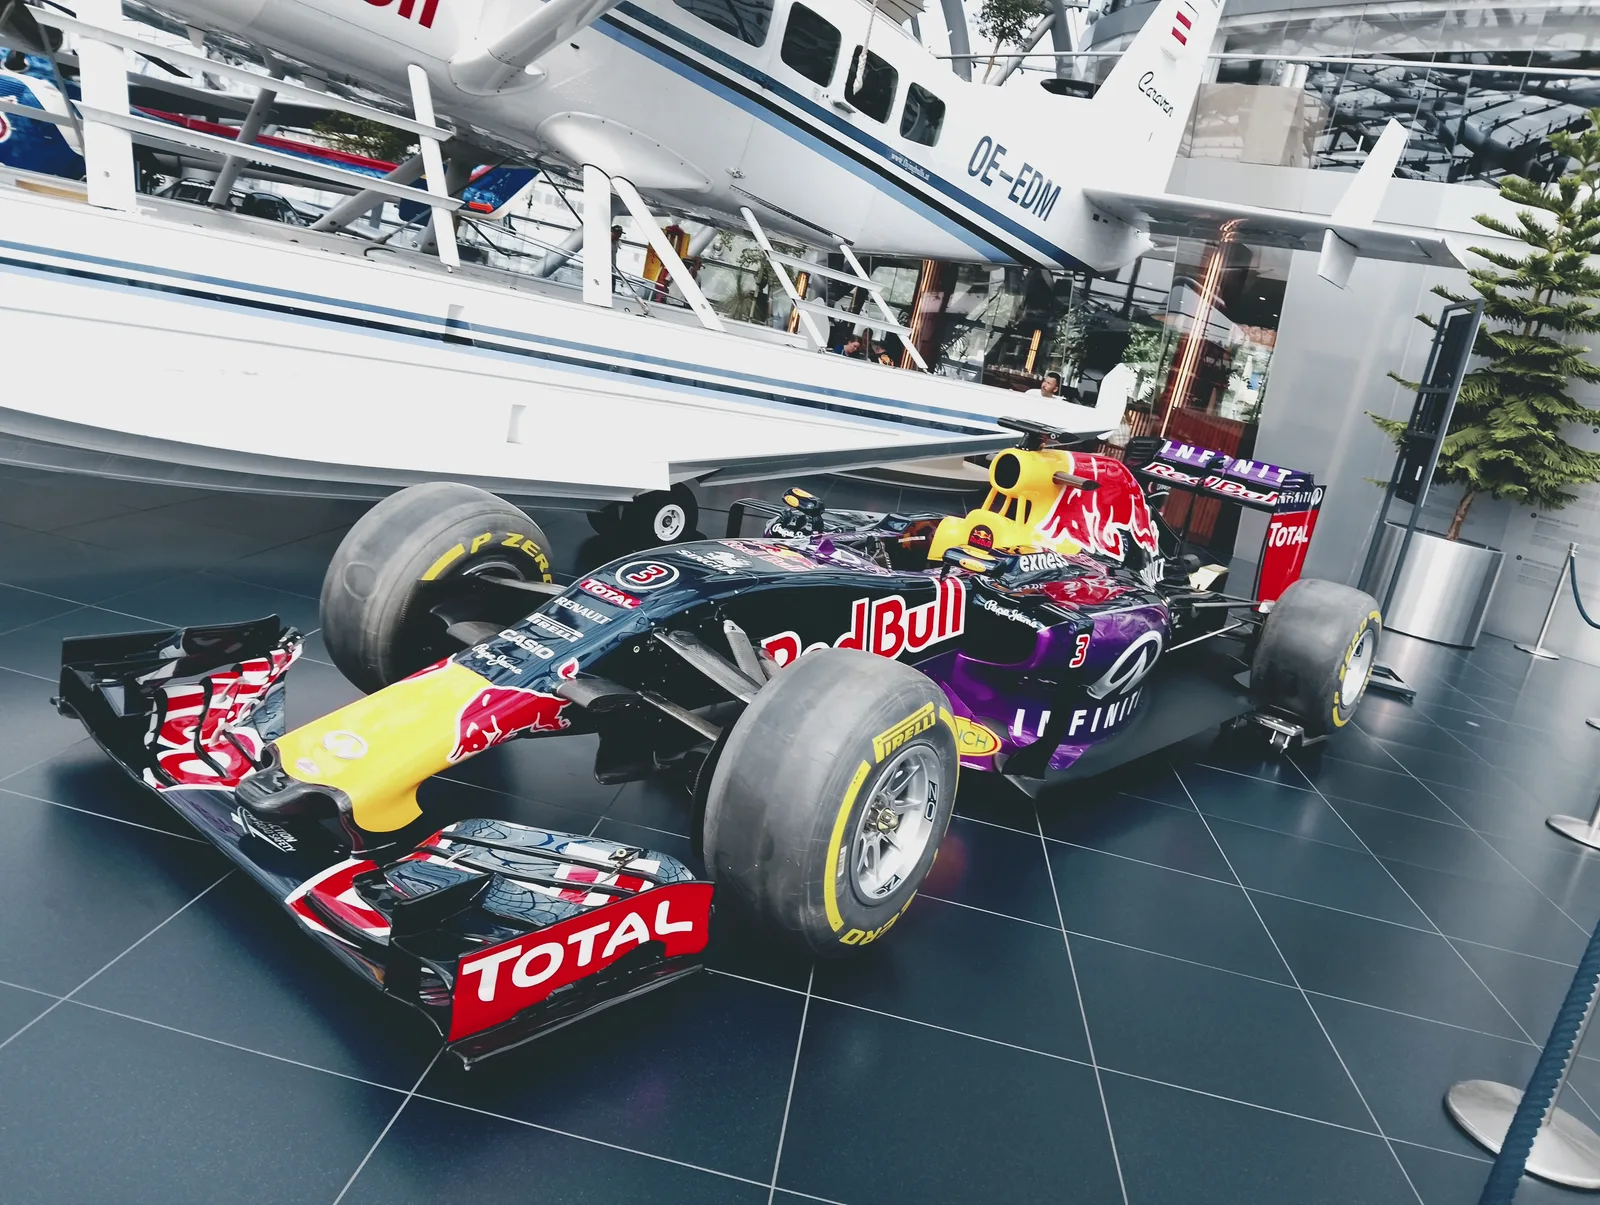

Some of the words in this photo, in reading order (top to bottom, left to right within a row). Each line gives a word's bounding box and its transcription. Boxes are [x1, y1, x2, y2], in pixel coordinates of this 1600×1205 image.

[1138, 71, 1174, 117] Caravan
[967, 135, 1062, 222] OE-EDM
[470, 532, 492, 554] P
[1267, 521, 1308, 548] TOTAL
[625, 564, 669, 584] 3
[1019, 551, 1069, 573] exness
[584, 579, 634, 609] TOTAL
[554, 596, 613, 625] RENAULT
[868, 576, 967, 661] Bull
[984, 600, 1010, 616] Pepe
[1008, 608, 1039, 629] Jeans
[525, 612, 585, 643] PIRELLI
[498, 628, 555, 660] CASIO
[1069, 633, 1091, 668] 3
[872, 701, 937, 764] PIRELLI
[268, 834, 297, 852] SAFETY
[462, 900, 693, 1002] TOTAL
